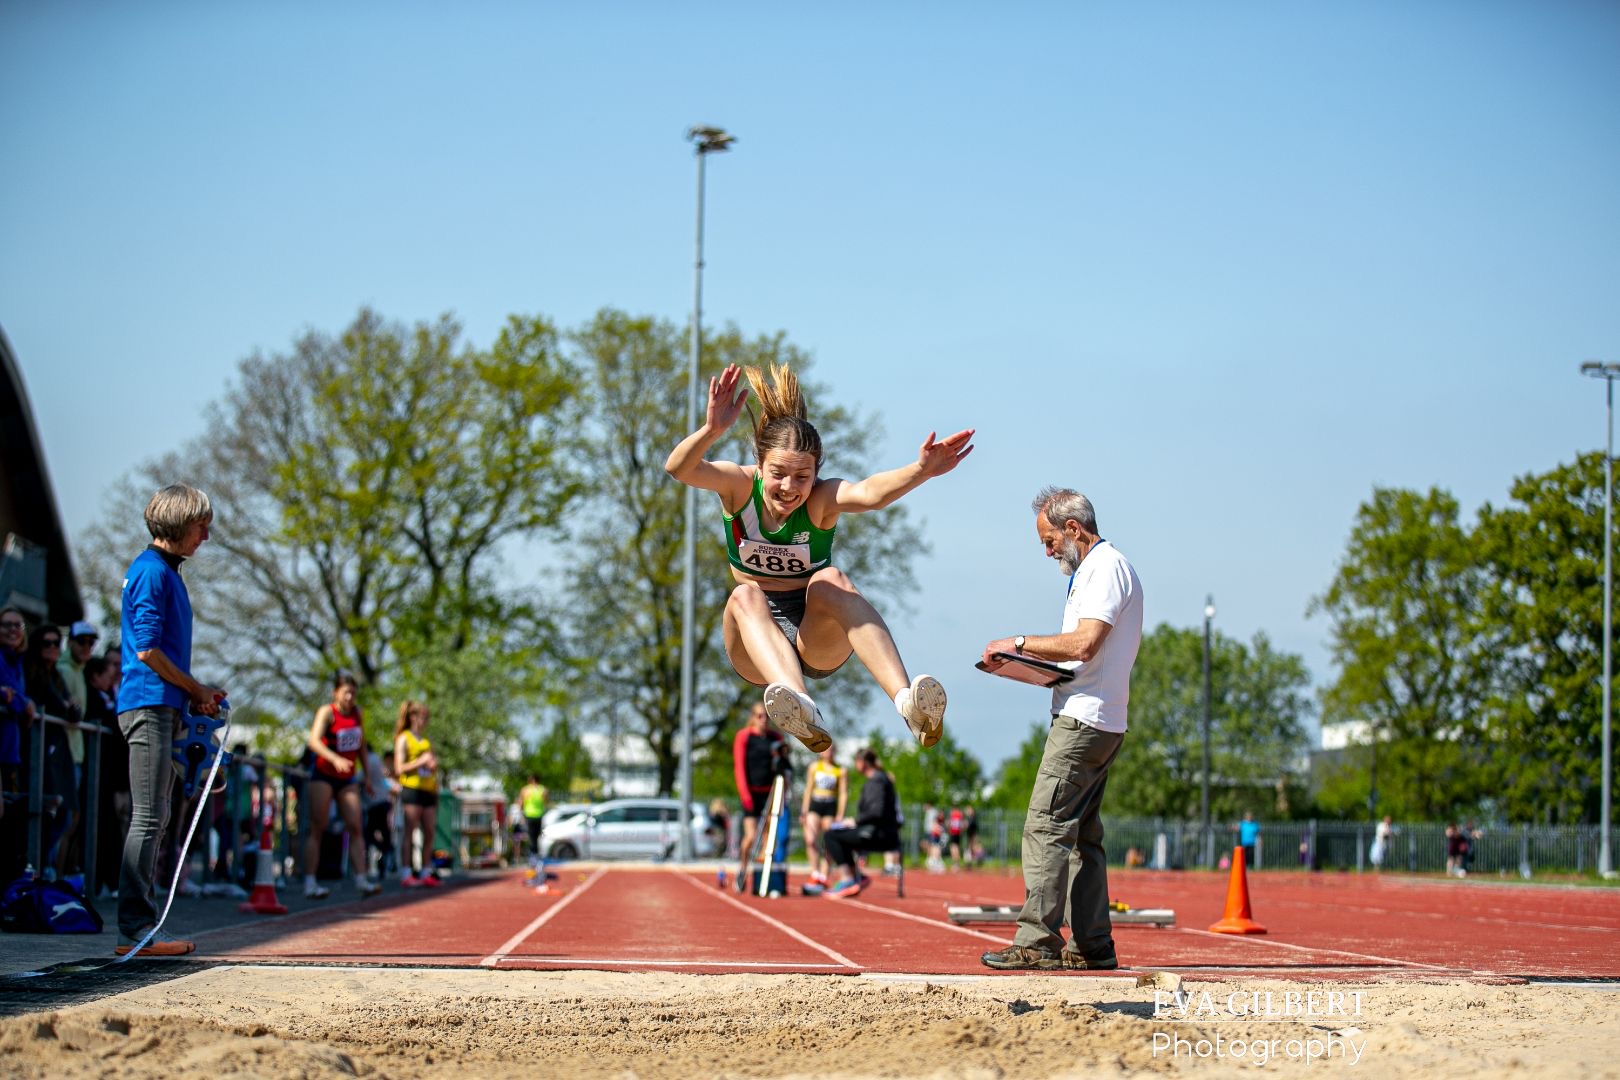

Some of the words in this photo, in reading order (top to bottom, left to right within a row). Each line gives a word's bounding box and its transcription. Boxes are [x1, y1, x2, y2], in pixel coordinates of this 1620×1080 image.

[753, 549, 796, 557] ATHLETICS
[759, 545, 788, 553] SUSSEX
[745, 554, 807, 572] 488
